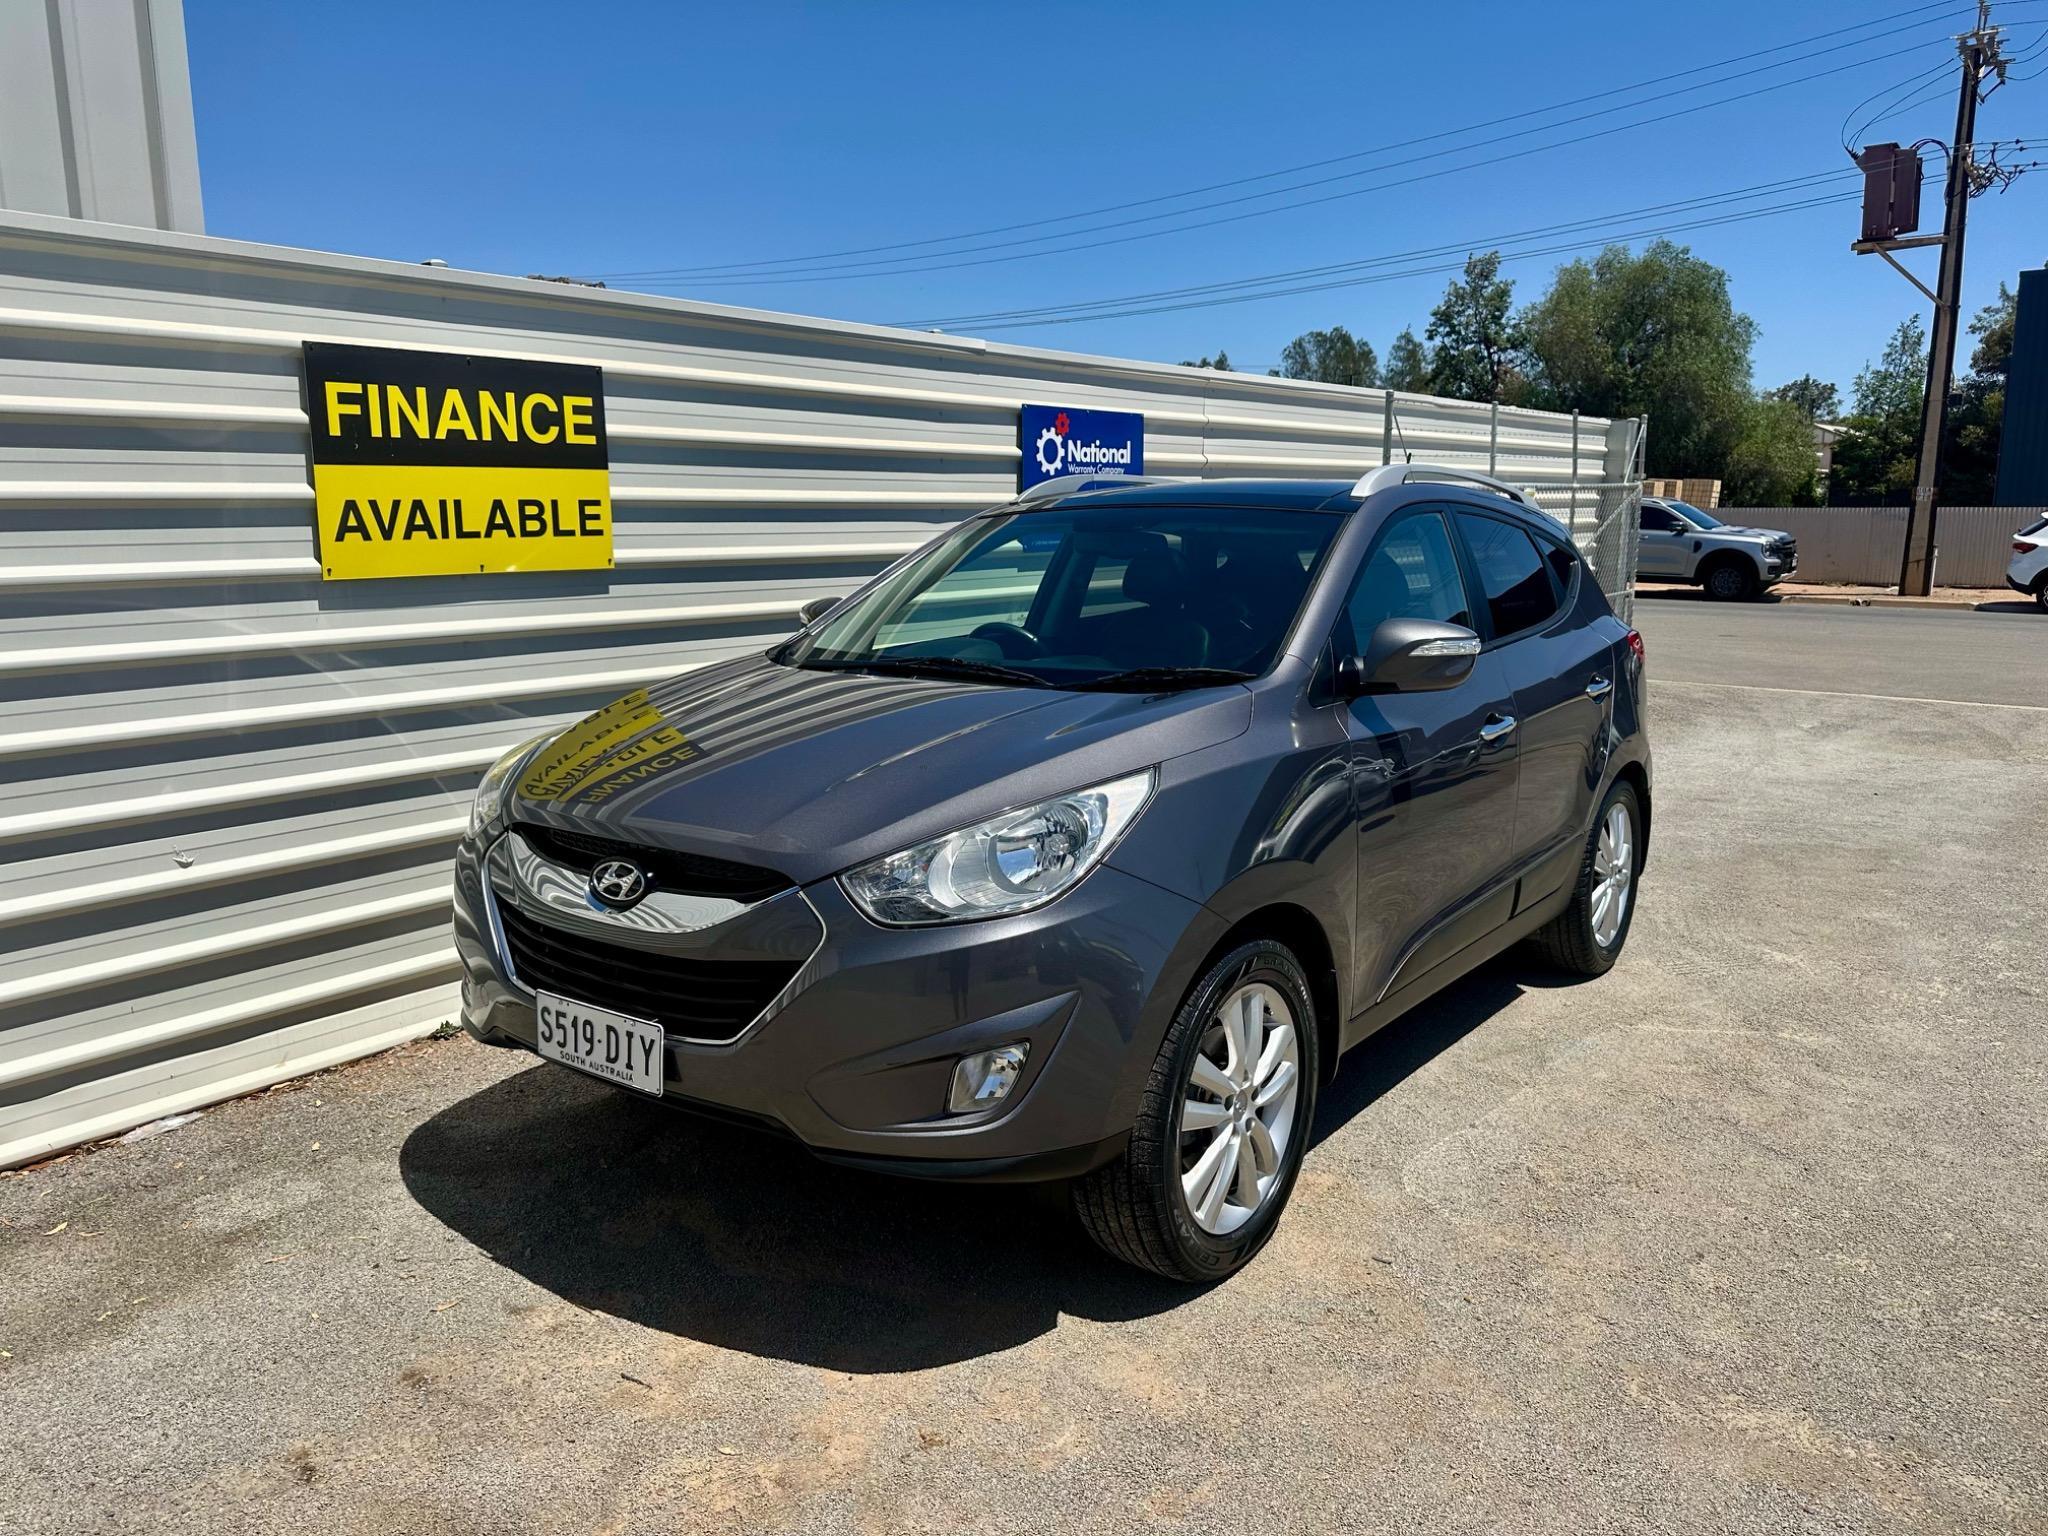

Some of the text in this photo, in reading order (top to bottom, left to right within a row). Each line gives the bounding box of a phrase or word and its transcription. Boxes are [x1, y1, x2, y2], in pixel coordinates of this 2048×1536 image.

[324, 381, 597, 445] FINANCE
[1067, 439, 1131, 464] National
[1067, 463, 1125, 475] Warranty Company
[334, 499, 604, 543] AVAILABLE
[560, 1050, 634, 1083] SOUTH AUSTRALIA
